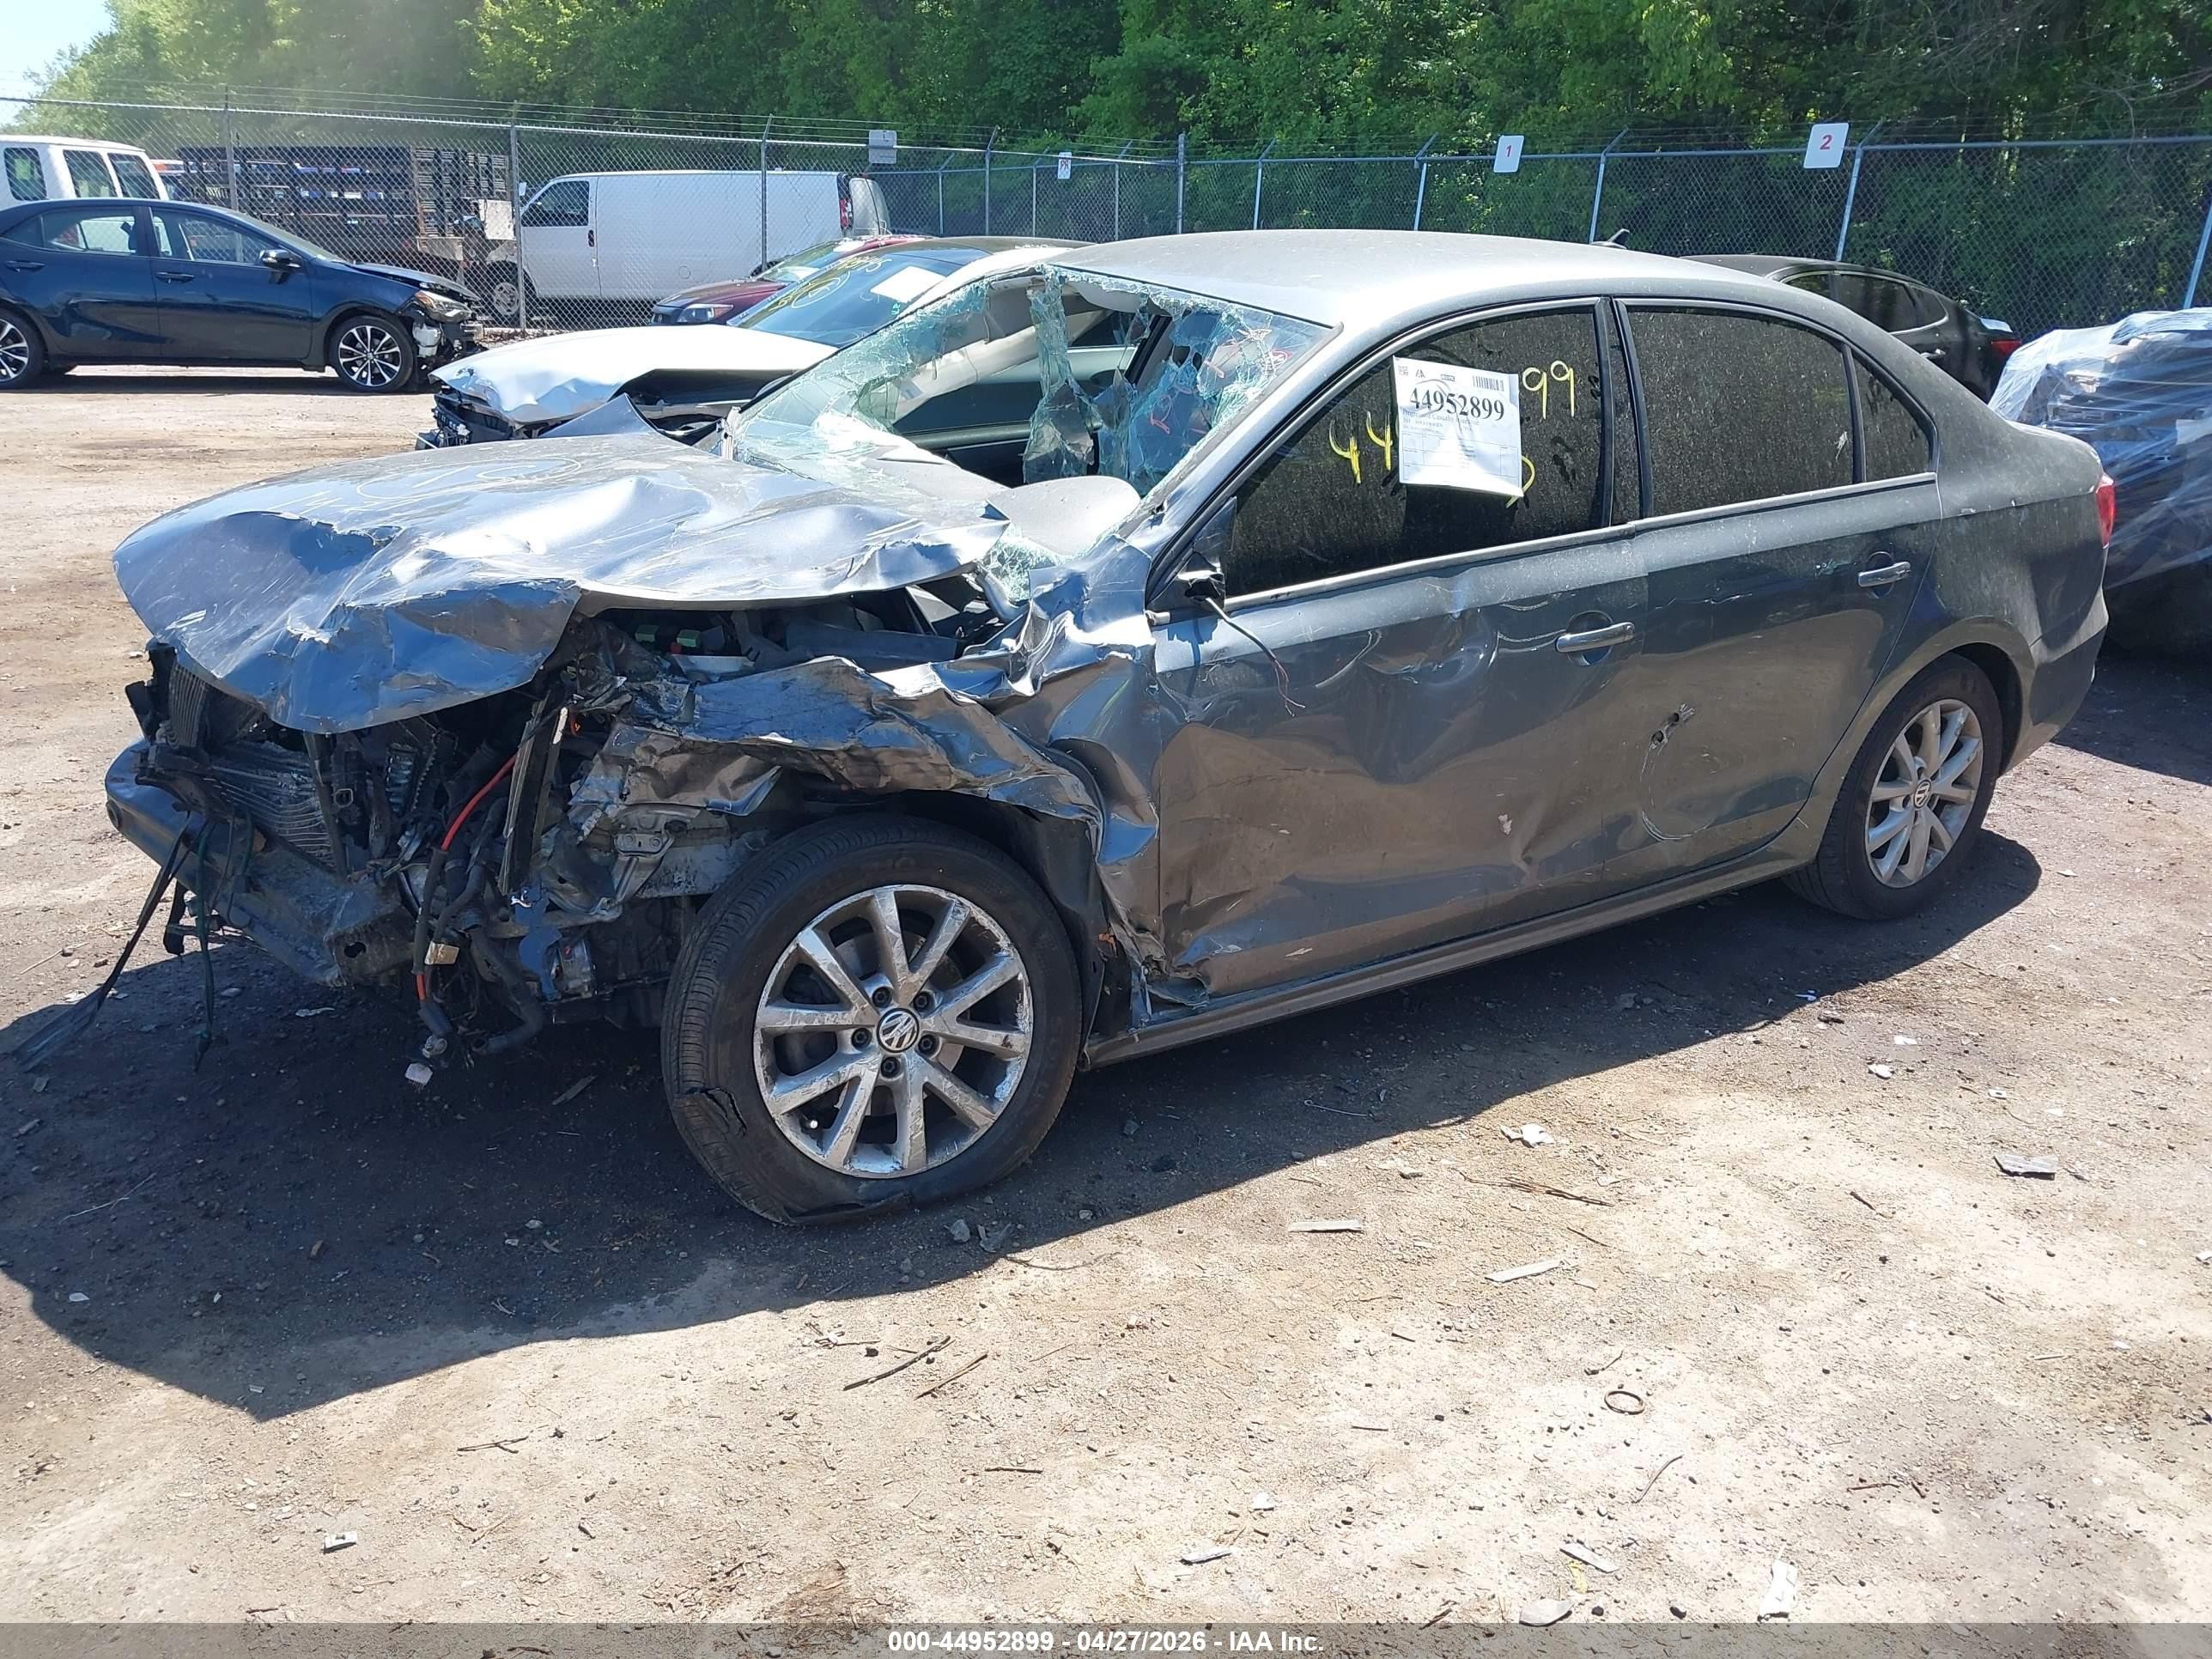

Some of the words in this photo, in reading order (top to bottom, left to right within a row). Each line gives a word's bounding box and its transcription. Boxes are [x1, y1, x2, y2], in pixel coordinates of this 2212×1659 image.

[1820, 134, 1833, 150] 2
[1504, 144, 1512, 158] 1
[1409, 387, 1505, 422] 44952899
